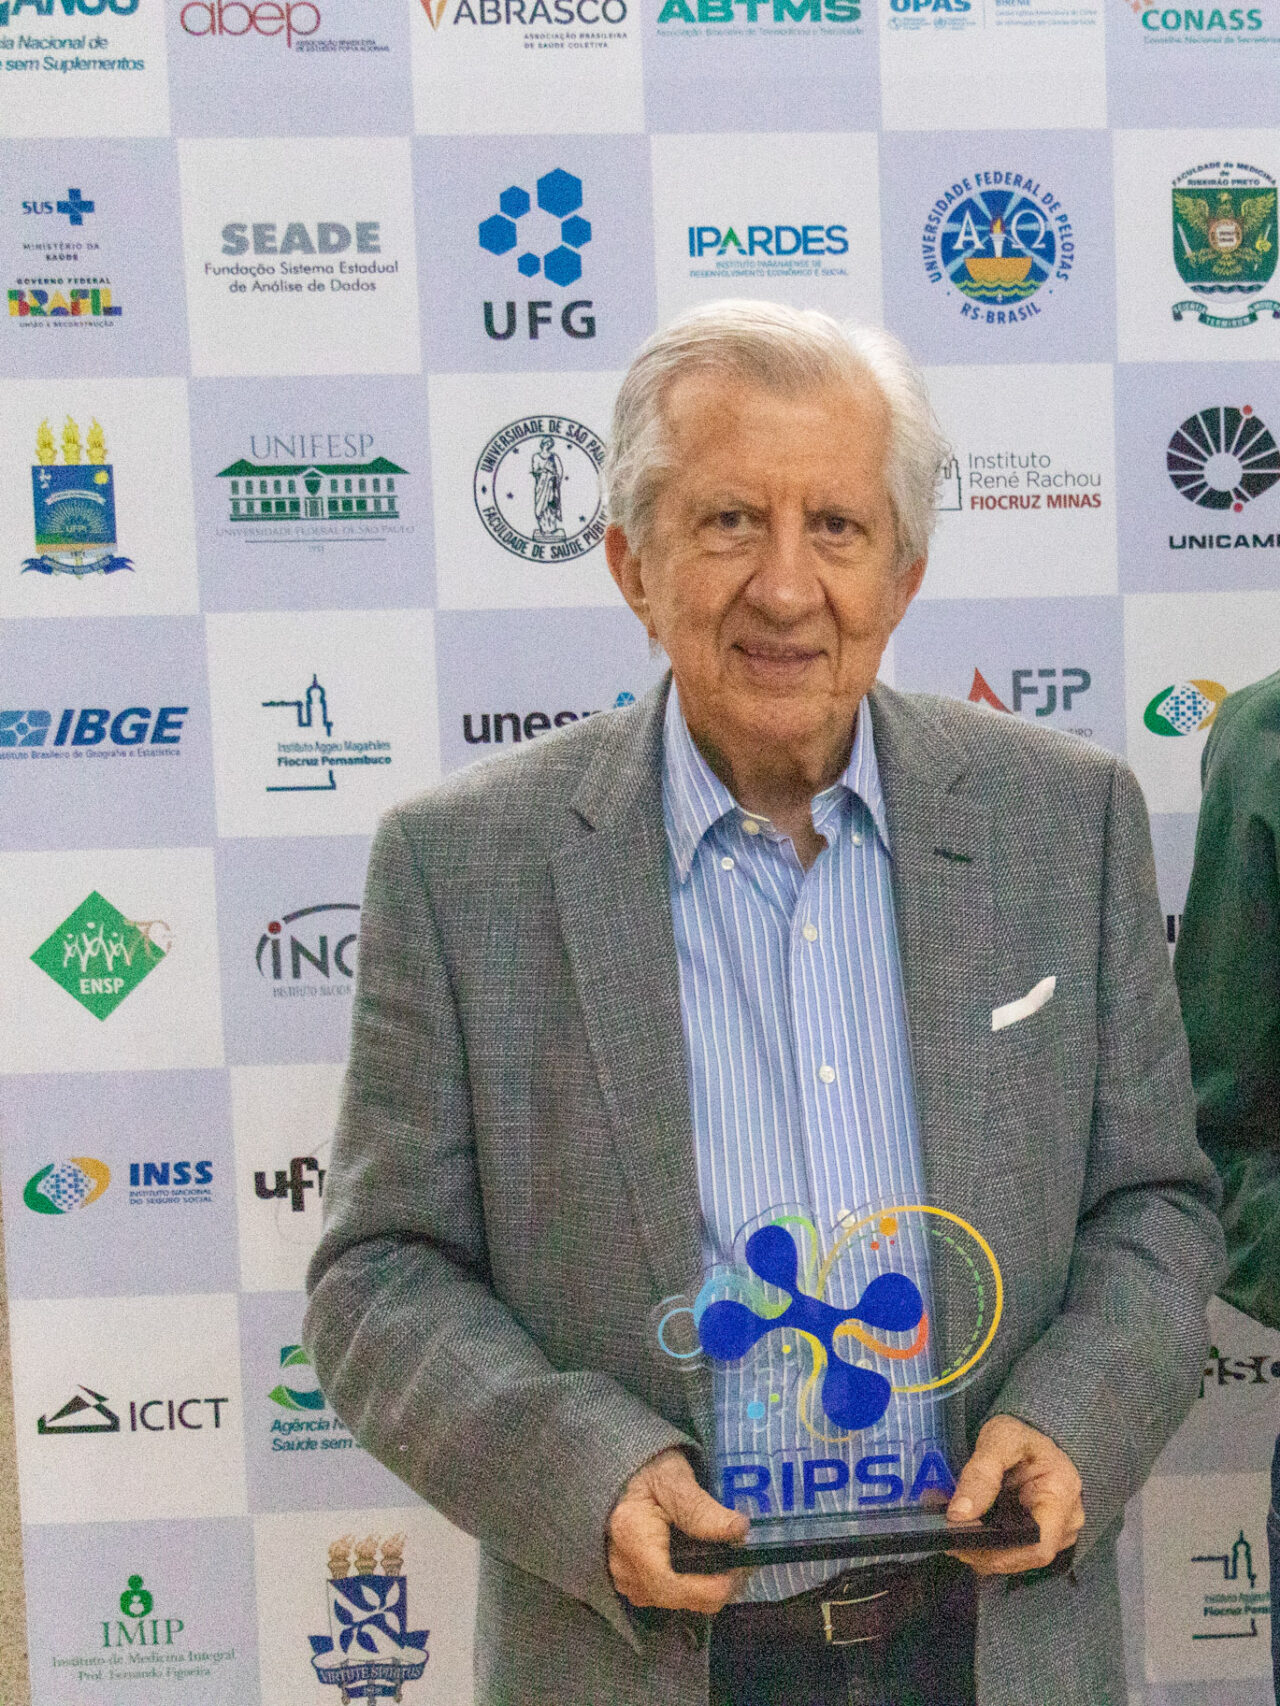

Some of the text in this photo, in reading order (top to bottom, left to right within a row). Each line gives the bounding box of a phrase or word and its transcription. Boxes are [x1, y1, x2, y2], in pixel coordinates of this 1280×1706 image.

[453, 0, 627, 25] ABRASCO
[657, 0, 861, 24] ABTMS
[1141, 8, 1263, 31] CONASS
[180, 0, 321, 48] abep
[18, 35, 109, 50] Nacional de
[578, 32, 627, 40] BRASILEIRA
[5, 56, 145, 74] sem Suplementos
[1172, 161, 1276, 187] FACULDADE MEDICINA
[1187, 177, 1260, 186] RIBEIRÃO PRETO
[21, 201, 54, 215] SUS
[221, 221, 381, 256] SEADE
[921, 170, 1075, 284] UNIVERSIDADE FEDERAL DE PELOTAS
[687, 224, 849, 258] IPARDES
[204, 260, 399, 278] Fundação Sistema Estadual
[17, 277, 111, 285] GOVERNO FEDERAL
[229, 279, 377, 293] de Análise de Dados
[7, 288, 122, 317] BRASIL
[483, 300, 597, 341] UFG
[250, 433, 375, 460] UNIFESP
[480, 419, 588, 474] UNIVERSIDADE DE SÃO
[968, 451, 1051, 469] Instituto
[968, 469, 1101, 488] René Rachou
[969, 492, 1102, 510] FIOCRUZ MINAS
[482, 506, 584, 559] FACULDADE DE SAÚDE
[1011, 668, 1091, 717] FJP
[53, 706, 189, 746] IBGE
[277, 755, 392, 767] Fiocruz Pernambuco
[79, 977, 125, 995] ENSP
[129, 1160, 213, 1187] INSS
[129, 1397, 229, 1431] ICICT
[270, 1417, 330, 1436] Agência
[272, 1436, 318, 1452] Saúde
[320, 1438, 353, 1450] sem
[722, 1450, 956, 1513] RIPSA
[101, 1618, 185, 1648] IMIP
[52, 1648, 235, 1668] Instituto de Medicina Integral
[321, 1666, 369, 1683] VIRTUTE
